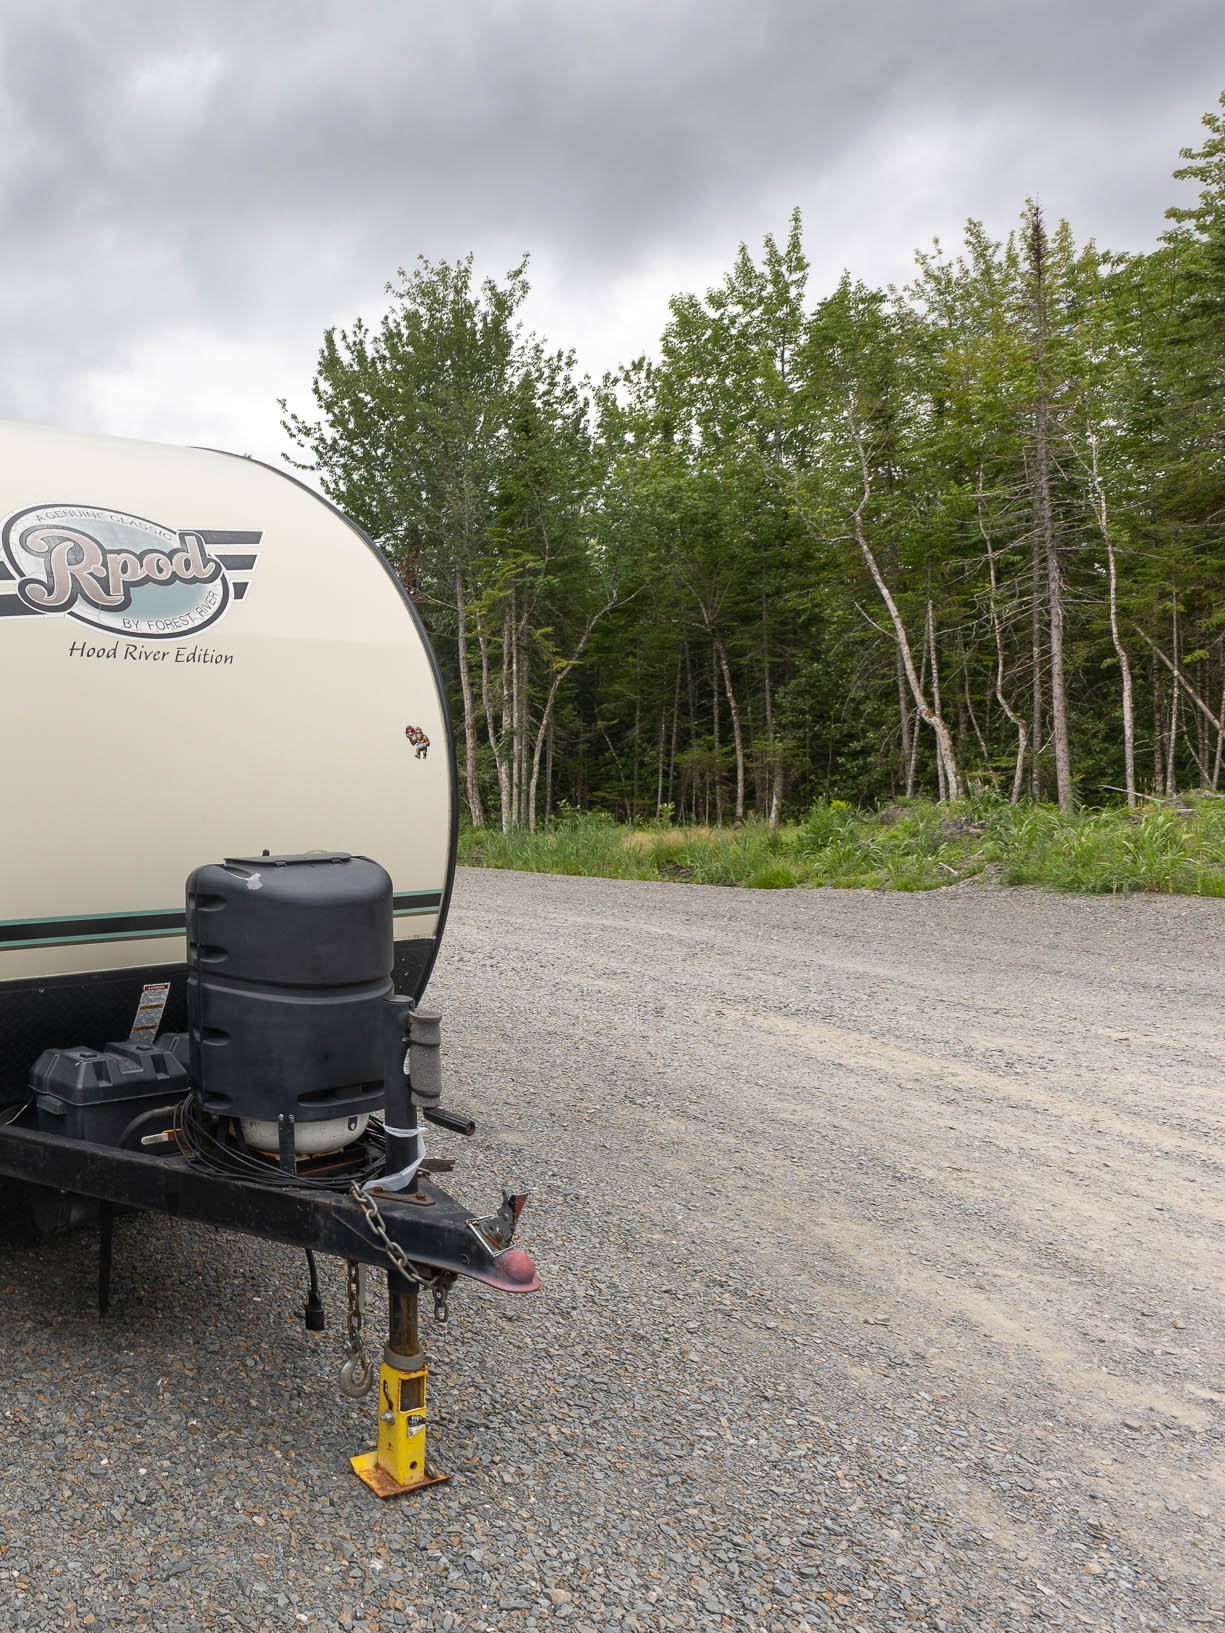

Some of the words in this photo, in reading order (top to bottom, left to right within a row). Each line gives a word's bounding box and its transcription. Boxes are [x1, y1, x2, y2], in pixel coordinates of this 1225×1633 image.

[45, 509, 104, 520] GENUINE
[110, 514, 173, 541] CLASSIC
[122, 617, 140, 629] BY
[147, 613, 196, 631] FOREST
[195, 590, 219, 618] RIVER
[69, 640, 120, 659] Hood
[124, 643, 170, 662] River
[175, 645, 234, 665] Edition
